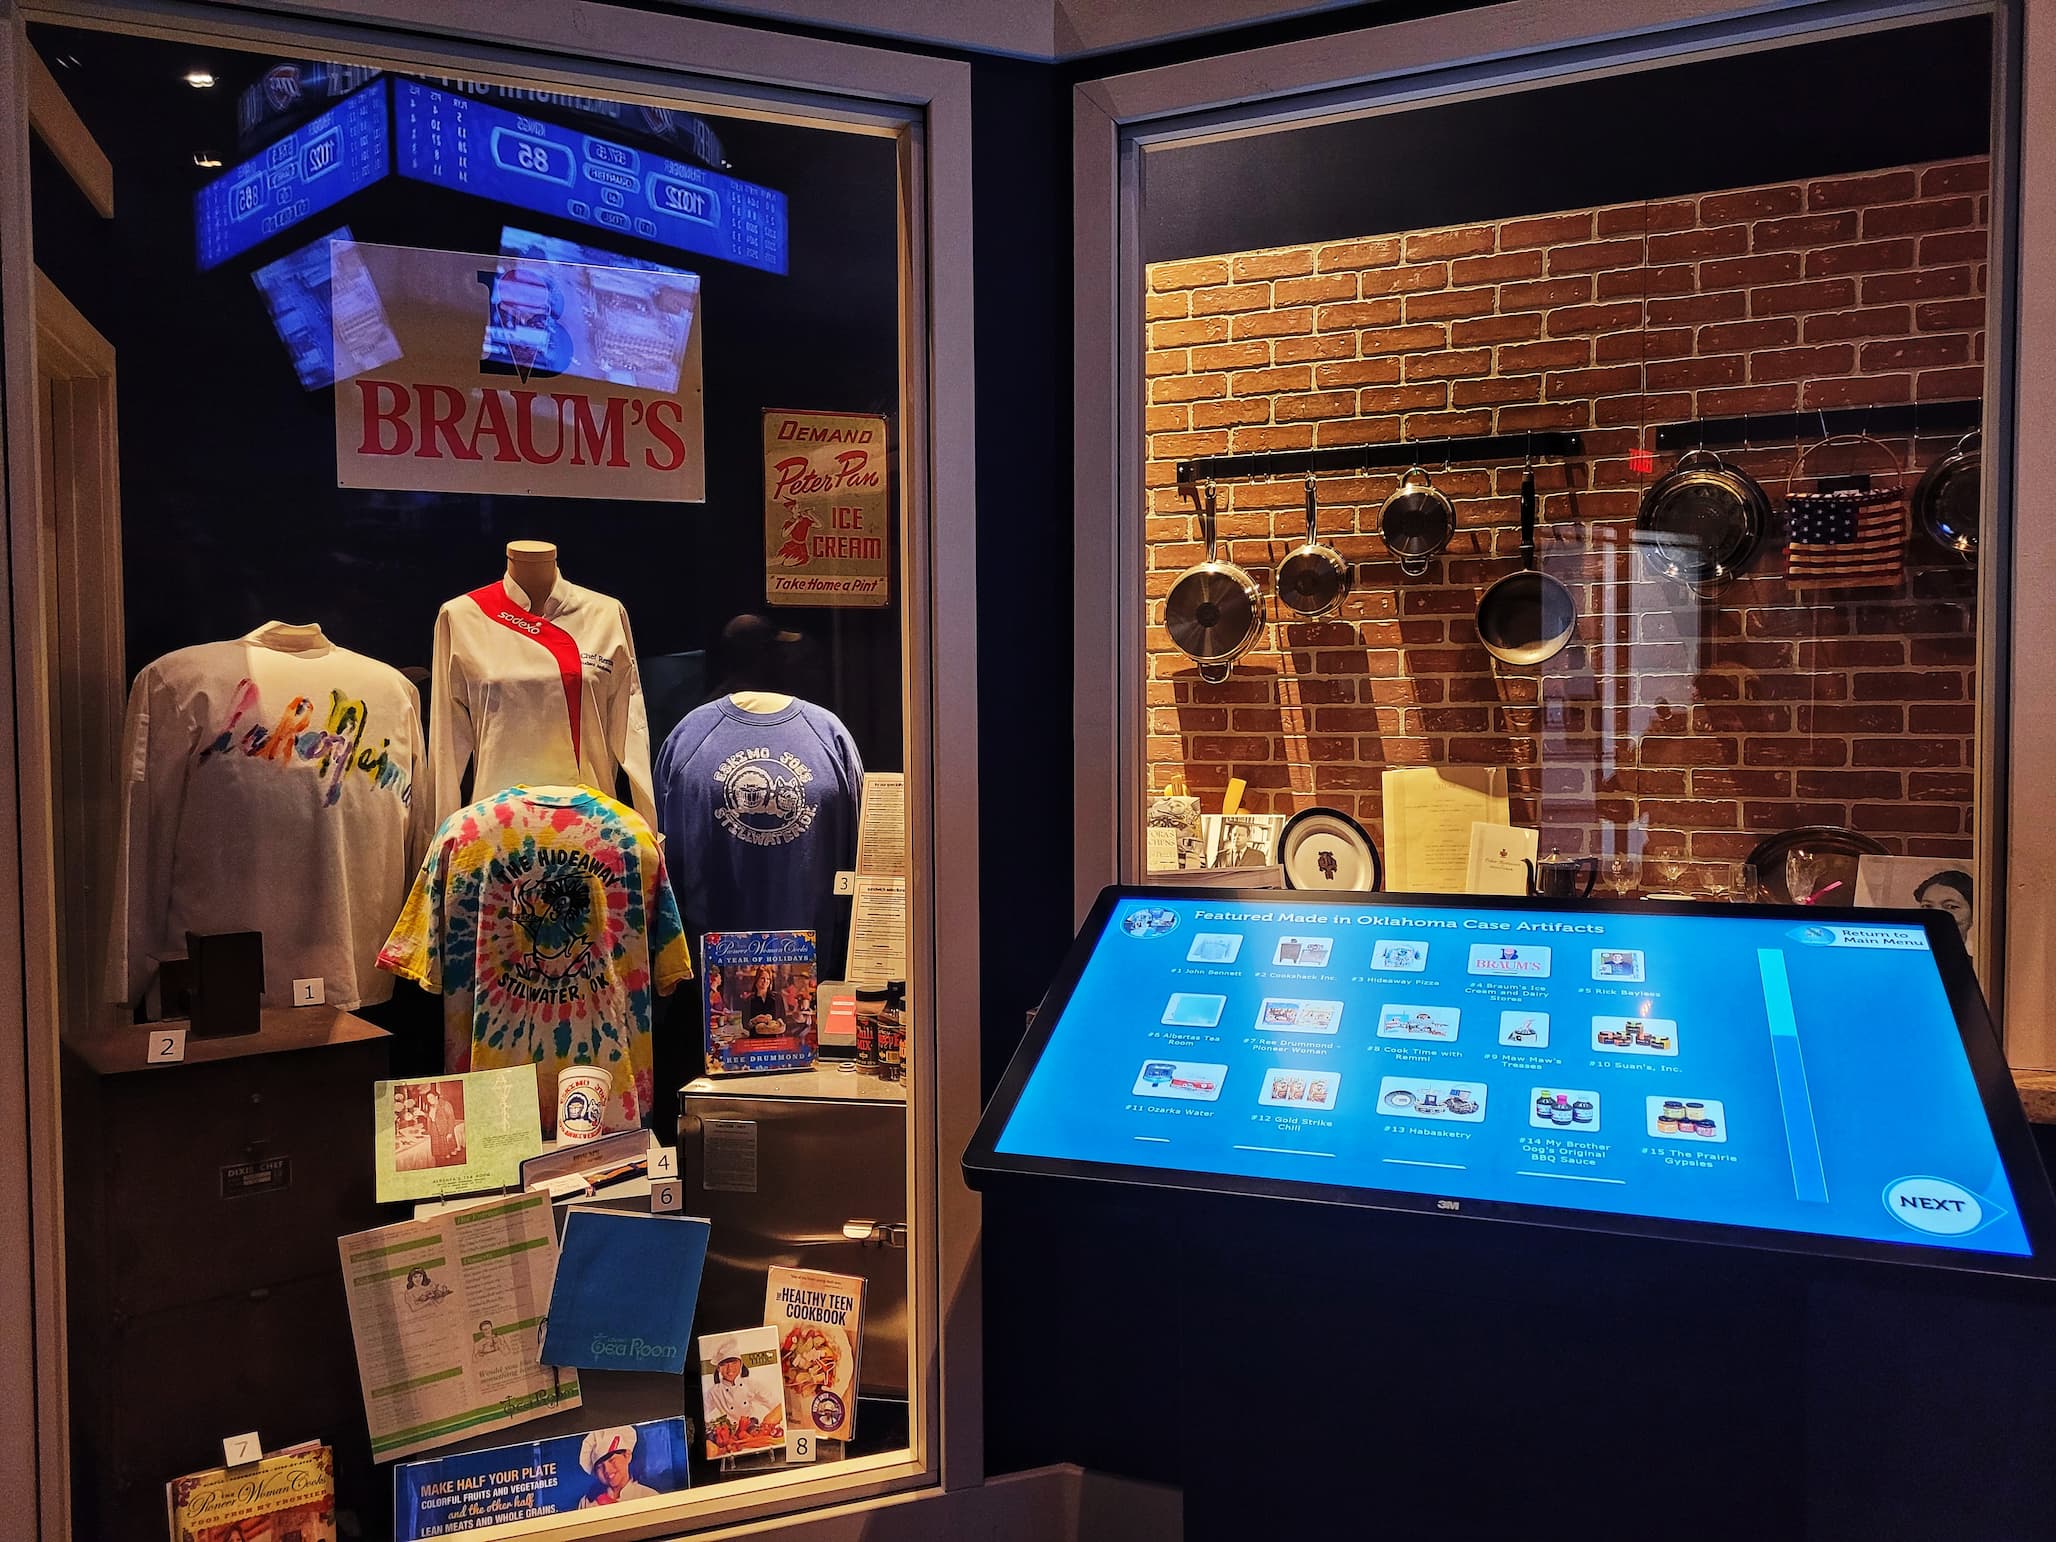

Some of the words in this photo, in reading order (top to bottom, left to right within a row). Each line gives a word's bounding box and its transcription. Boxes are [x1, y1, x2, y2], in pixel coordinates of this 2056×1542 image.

[356, 380, 687, 472] BRAUM'S
[777, 421, 873, 443] DEMAND
[774, 457, 833, 499] Peter
[834, 450, 879, 487] Pan
[832, 506, 864, 530] ICE
[813, 536, 881, 560] CREAM
[807, 579, 841, 591] Home
[842, 582, 850, 591] a
[497, 610, 542, 635] sodexo
[713, 747, 770, 782] ESKIMO
[779, 751, 813, 783] JOE'S
[497, 856, 533, 884] THE
[539, 849, 622, 888] HIDEAWAY
[841, 877, 848, 890] 3
[1194, 910, 1273, 922] Featured
[1278, 913, 1328, 924] Made
[1334, 914, 1351, 925] in
[1357, 916, 1457, 929] Oklahoma
[1463, 919, 1510, 930] Case
[1516, 921, 1605, 934] Artifacts
[1842, 929, 1890, 938] Return
[1844, 936, 1879, 945] Main
[1883, 937, 1924, 946] Menu
[726, 956, 749, 964] YEAR
[766, 955, 809, 963] HOLIDAYS
[1476, 959, 1541, 971] BRAUM'S
[590, 974, 610, 993] OK
[1367, 977, 1412, 985] Hideaway
[304, 985, 315, 1000] 1
[1522, 990, 1550, 998] Dairy
[160, 1038, 174, 1056] 2
[1252, 1045, 1288, 1053] Pioneer
[1292, 1047, 1328, 1055] Woman
[1280, 1040, 1334, 1049] Drummond
[1384, 1046, 1408, 1054] Cook
[1412, 1048, 1437, 1056] Time
[1441, 1050, 1463, 1058] with
[726, 1055, 745, 1063] REE
[750, 1053, 805, 1061] DRUMMOND
[1529, 1056, 1562, 1065] Maw's
[1661, 1065, 1683, 1073] Inc.
[1185, 1109, 1214, 1117] Water
[1275, 1116, 1298, 1124] Gold
[1302, 1118, 1333, 1127] Strike
[1278, 1124, 1301, 1132] Chili
[1409, 1128, 1472, 1140] Habasketry
[1519, 1137, 1541, 1145] #14
[1545, 1139, 1562, 1148] My
[1566, 1141, 1612, 1151] Brother
[1531, 1154, 1556, 1164] BBQ
[1560, 1155, 1596, 1166] Sauce
[1559, 1148, 1606, 1159] Original
[1641, 1147, 1665, 1156] #15
[1669, 1149, 1692, 1158] The
[1696, 1152, 1738, 1162] Prairie
[657, 1154, 670, 1171] 4
[1664, 1157, 1713, 1169] Gypsies
[660, 1188, 672, 1204] 6
[1900, 1195, 1965, 1212] NEXT
[1437, 1200, 1460, 1211] 3M
[782, 1287, 826, 1307] HEALTHY
[829, 1294, 853, 1311] TEEN
[786, 1303, 846, 1326] COOKBOOK
[630, 1337, 676, 1360] Room
[234, 1441, 249, 1457] 7
[796, 1437, 808, 1455] 8
[420, 1482, 454, 1498] MAKE
[456, 1476, 486, 1491] HALF
[489, 1469, 520, 1485] YOUR
[522, 1462, 557, 1479] PLATE
[187, 1488, 237, 1518] Pioneer
[237, 1472, 289, 1502] Woman
[287, 1470, 327, 1490] Cooks
[421, 1496, 462, 1510] COLORFUL
[463, 1489, 491, 1502] FRUITS
[492, 1487, 509, 1498] AND
[510, 1478, 558, 1495] VEGETABLES
[191, 1515, 219, 1527] FOOD
[224, 1508, 253, 1519] FROM
[257, 1502, 272, 1511] MY
[276, 1489, 327, 1507] FRONTIER
[448, 1505, 467, 1520] and
[468, 1502, 485, 1516] the
[486, 1498, 513, 1513] other
[513, 1492, 535, 1510] half
[421, 1524, 443, 1538] LEAN
[444, 1518, 474, 1533] MEATS
[475, 1515, 493, 1528] AND
[494, 1510, 525, 1525] WHOLE
[525, 1504, 559, 1519] GRAINS.
